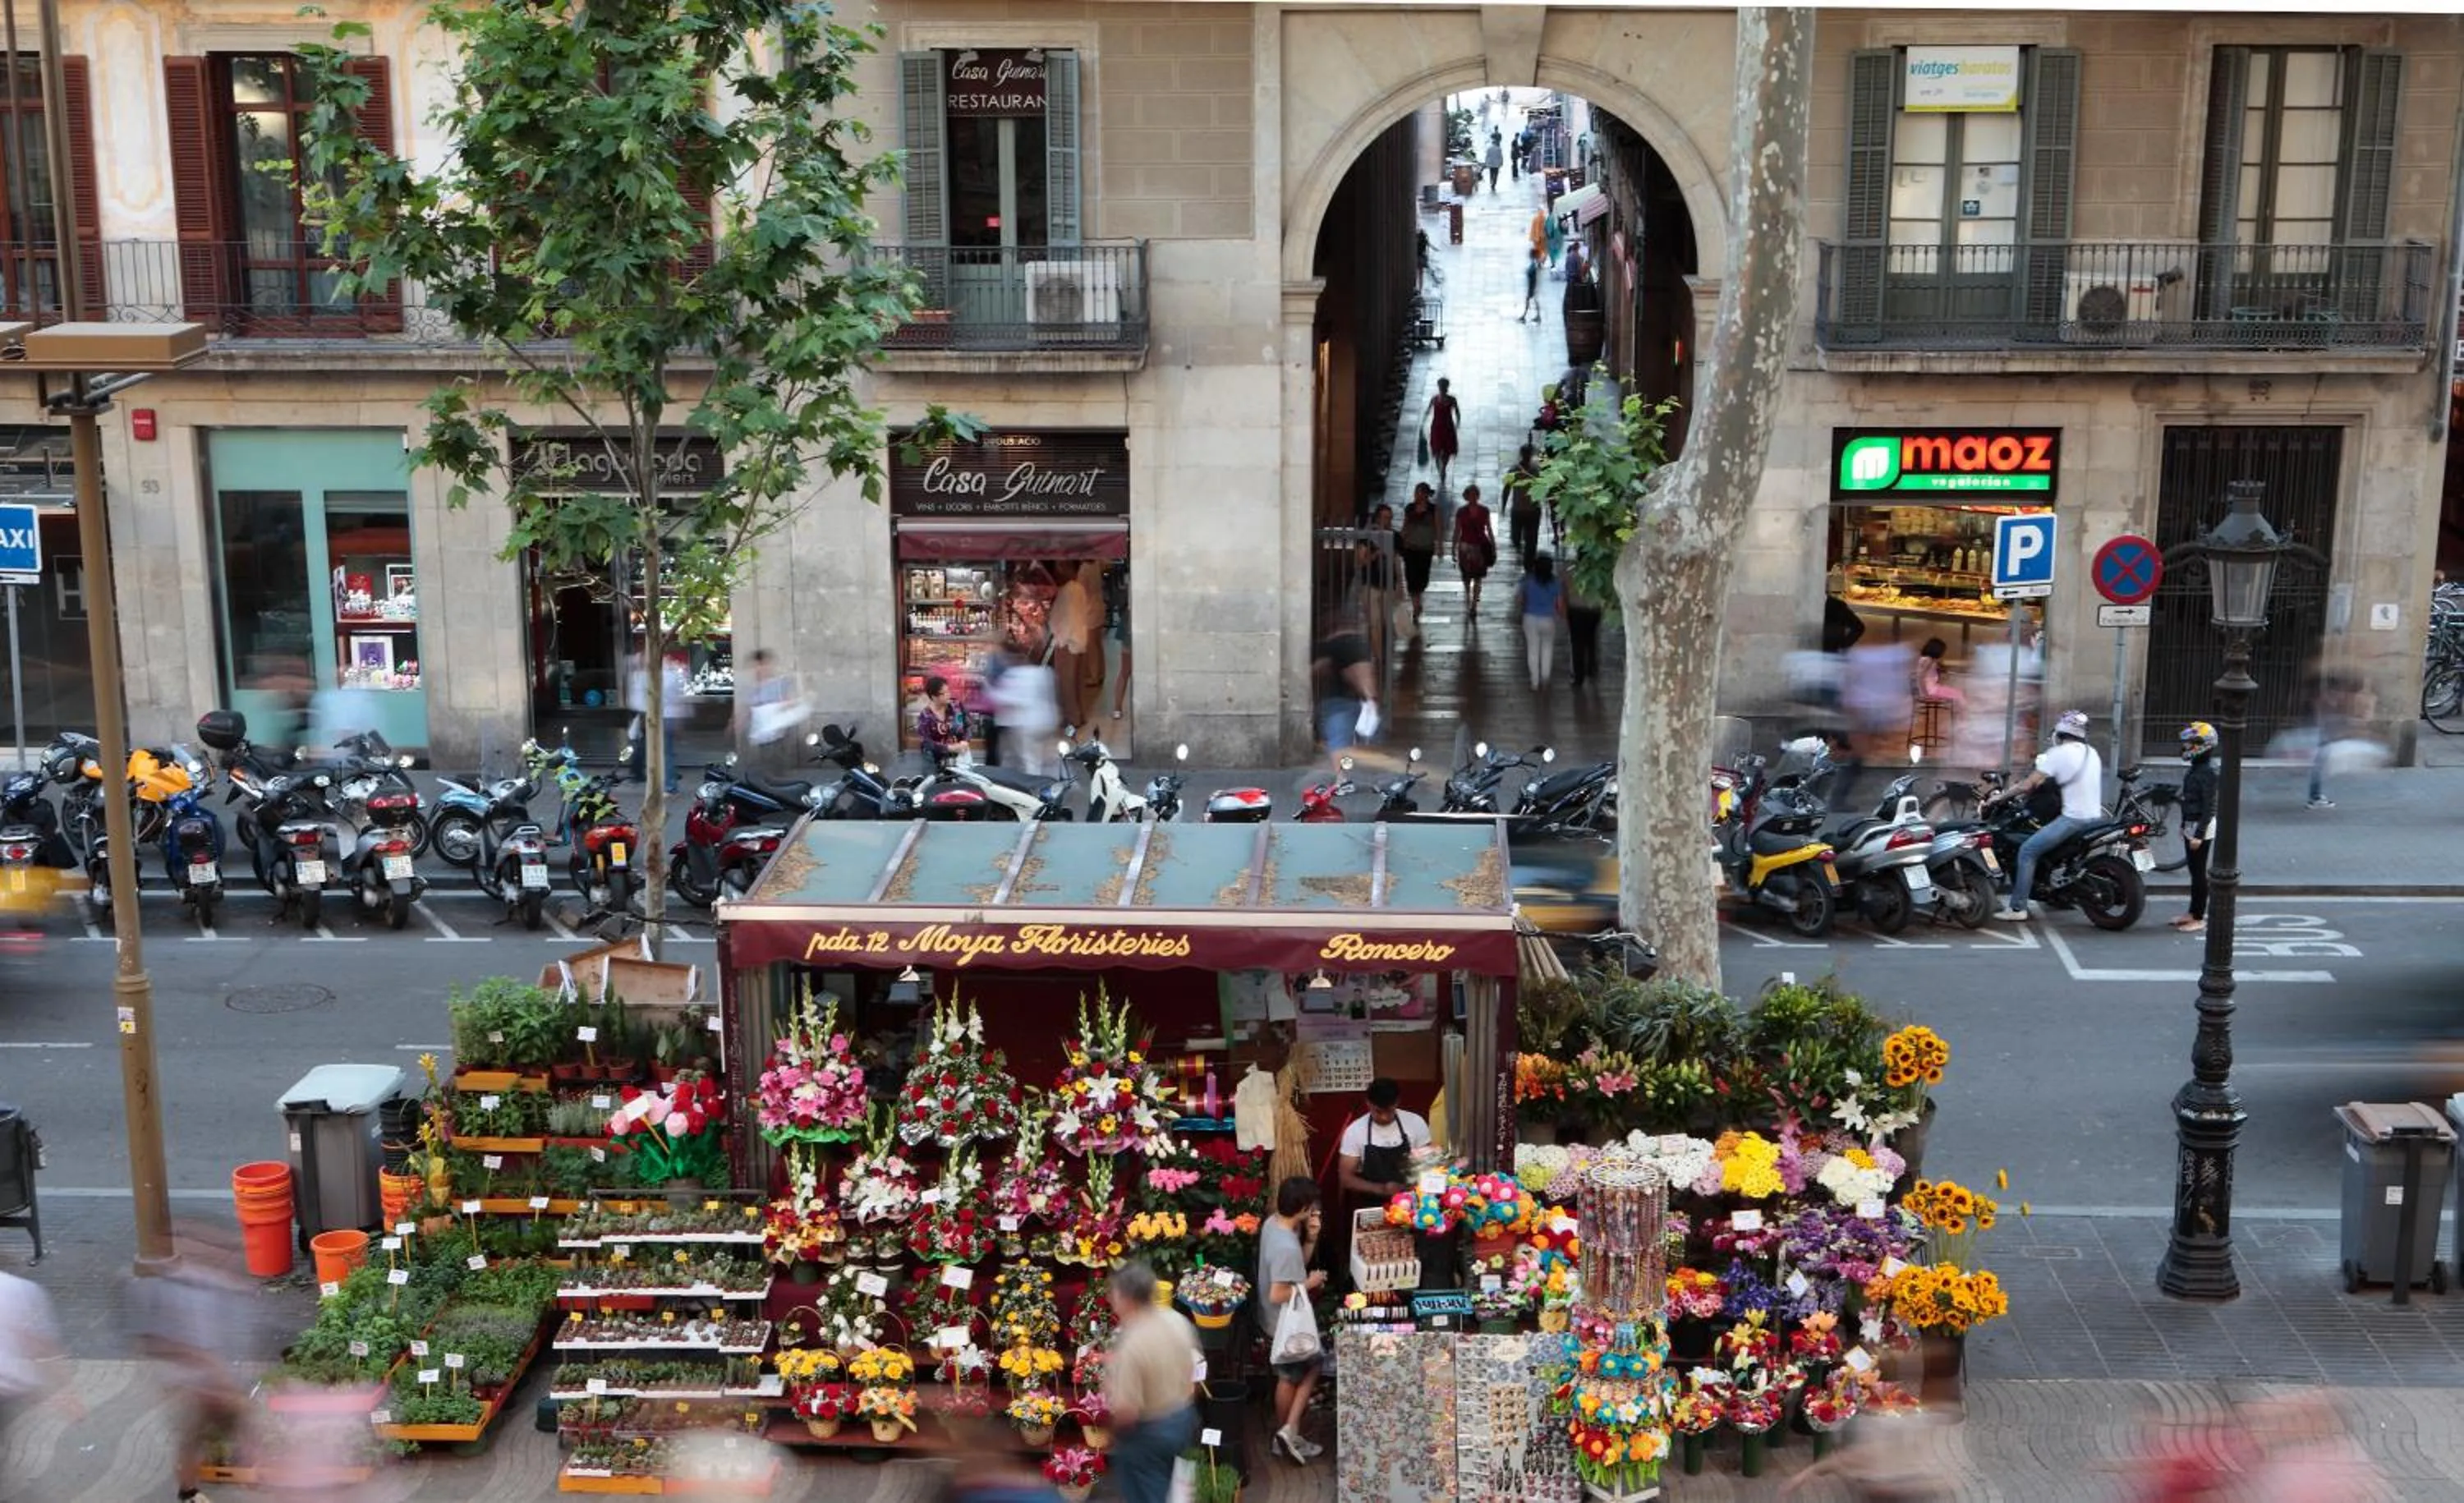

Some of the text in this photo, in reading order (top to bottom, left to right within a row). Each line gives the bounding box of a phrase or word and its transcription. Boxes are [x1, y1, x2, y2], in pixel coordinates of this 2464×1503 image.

[953, 57, 1046, 87] Casa Guinar
[1901, 436, 2052, 471] maoz
[923, 456, 1106, 502] Casa Guinart
[2007, 525, 2044, 576] P
[898, 925, 1004, 966] Moya
[1011, 925, 1191, 956] Floristeries
[1320, 932, 1455, 962] Roncero
